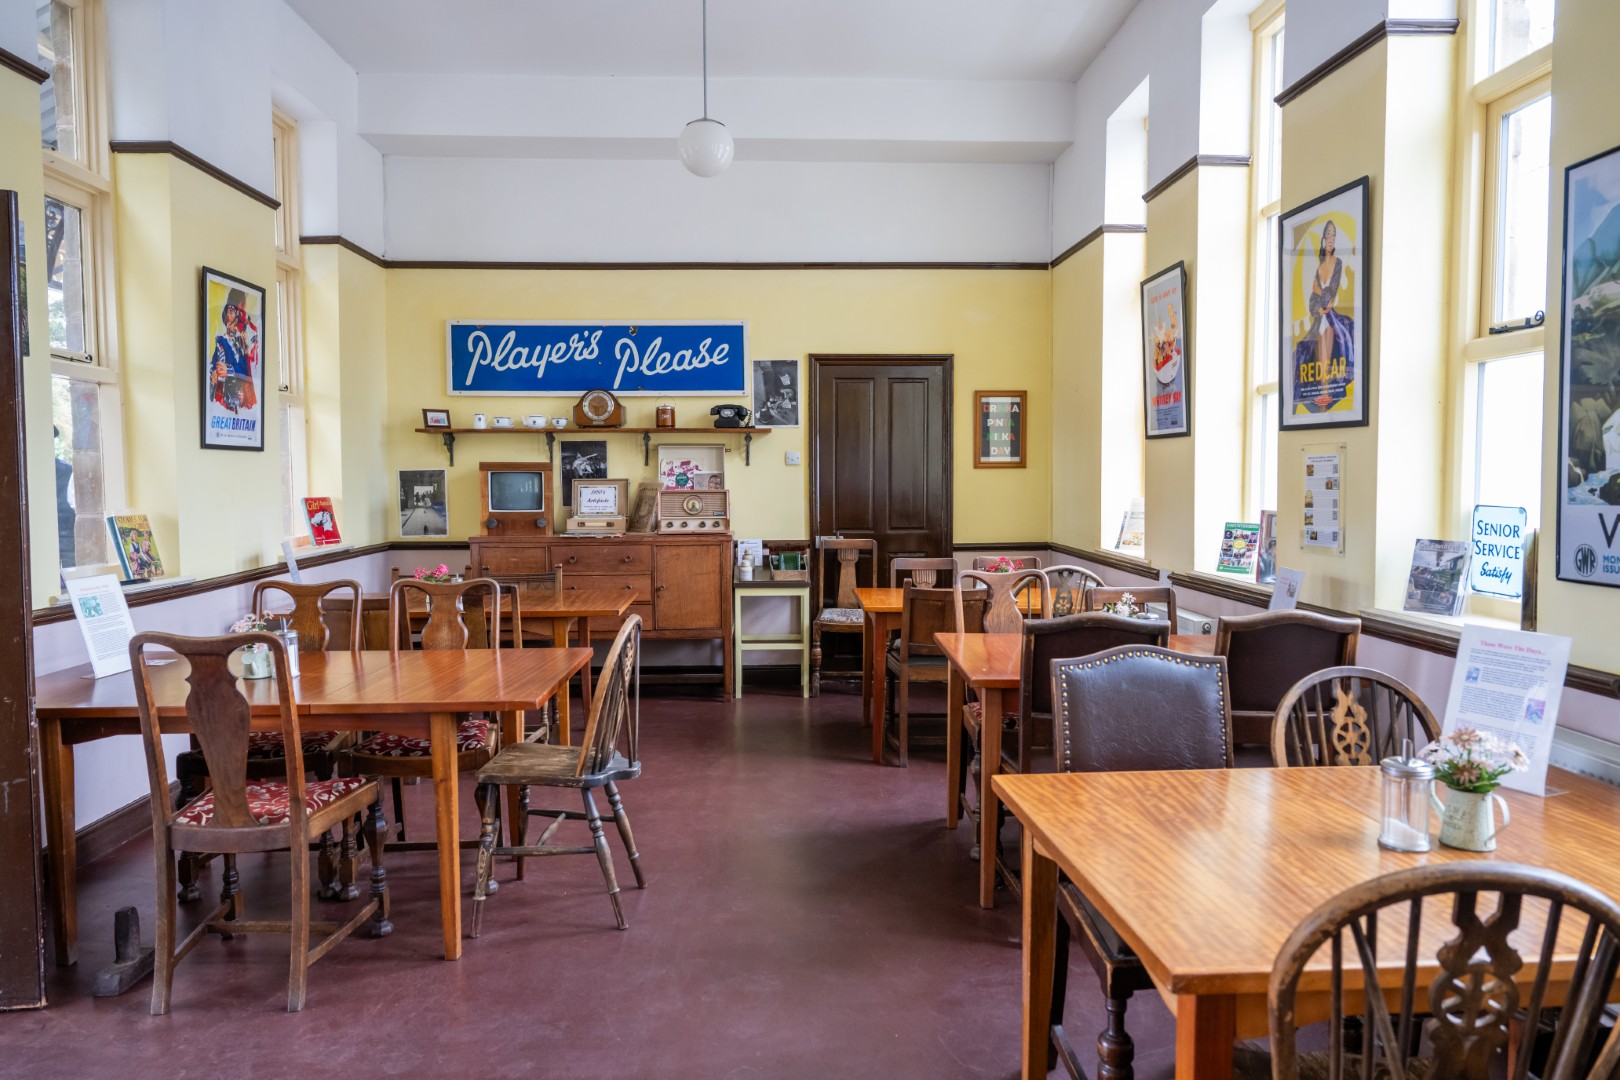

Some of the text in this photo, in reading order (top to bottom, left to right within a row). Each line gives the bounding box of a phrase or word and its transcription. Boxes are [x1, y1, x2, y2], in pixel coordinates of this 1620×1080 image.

[465, 330, 730, 390] Player's Please
[1300, 357, 1347, 383] REDCAR
[983, 404, 1019, 413] DRINKA
[210, 415, 257, 432] GREAT BRITAIN
[986, 418, 1015, 427] PINTA
[990, 446, 1011, 455] DAY
[306, 500, 320, 510] Girl
[1476, 520, 1520, 538] SENIOR
[1475, 540, 1520, 560] SERVICE
[1575, 546, 1596, 575] GWR
[1479, 561, 1513, 585] Satisfy
